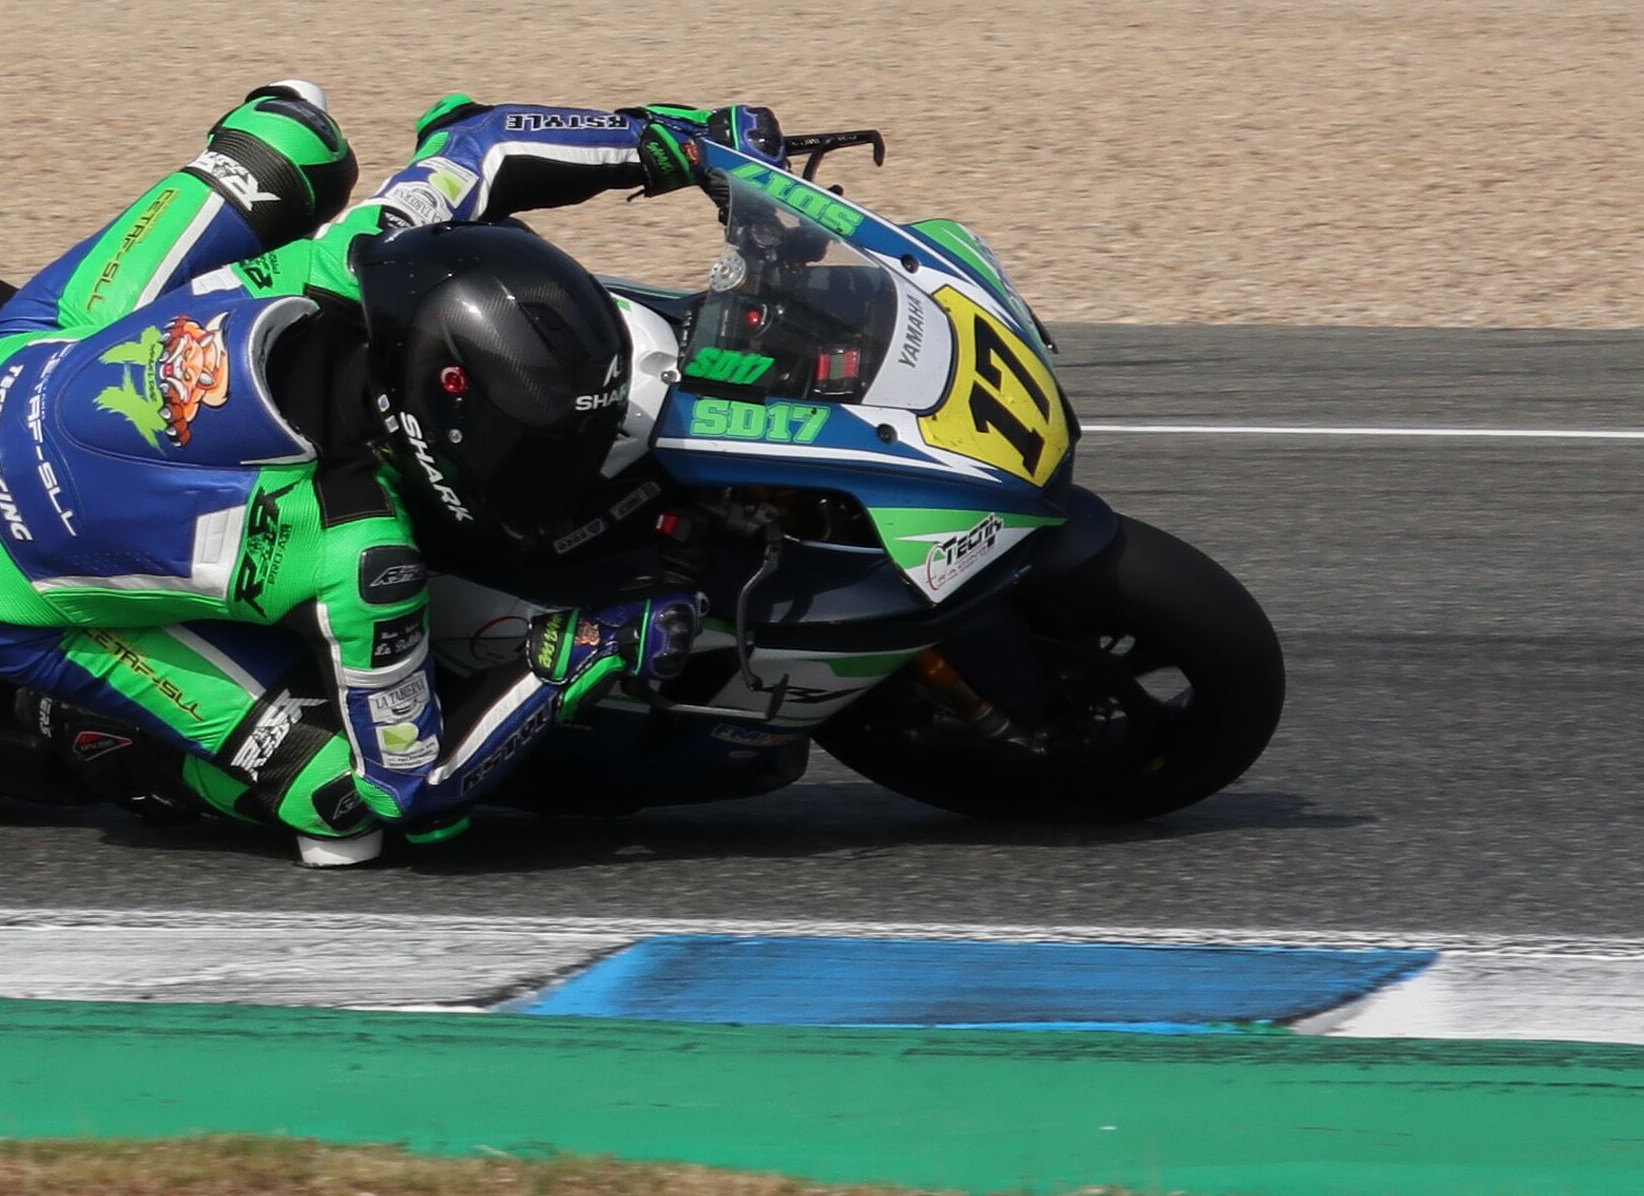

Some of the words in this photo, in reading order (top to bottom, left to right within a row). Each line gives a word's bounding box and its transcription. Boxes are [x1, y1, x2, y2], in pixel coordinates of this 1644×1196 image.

[504, 112, 629, 132] RSTYLE
[898, 293, 924, 367] YAMAHA
[683, 346, 776, 385] SD17
[690, 399, 833, 442] SD17
[968, 312, 1051, 478] 17
[400, 412, 473, 521] SHARK
